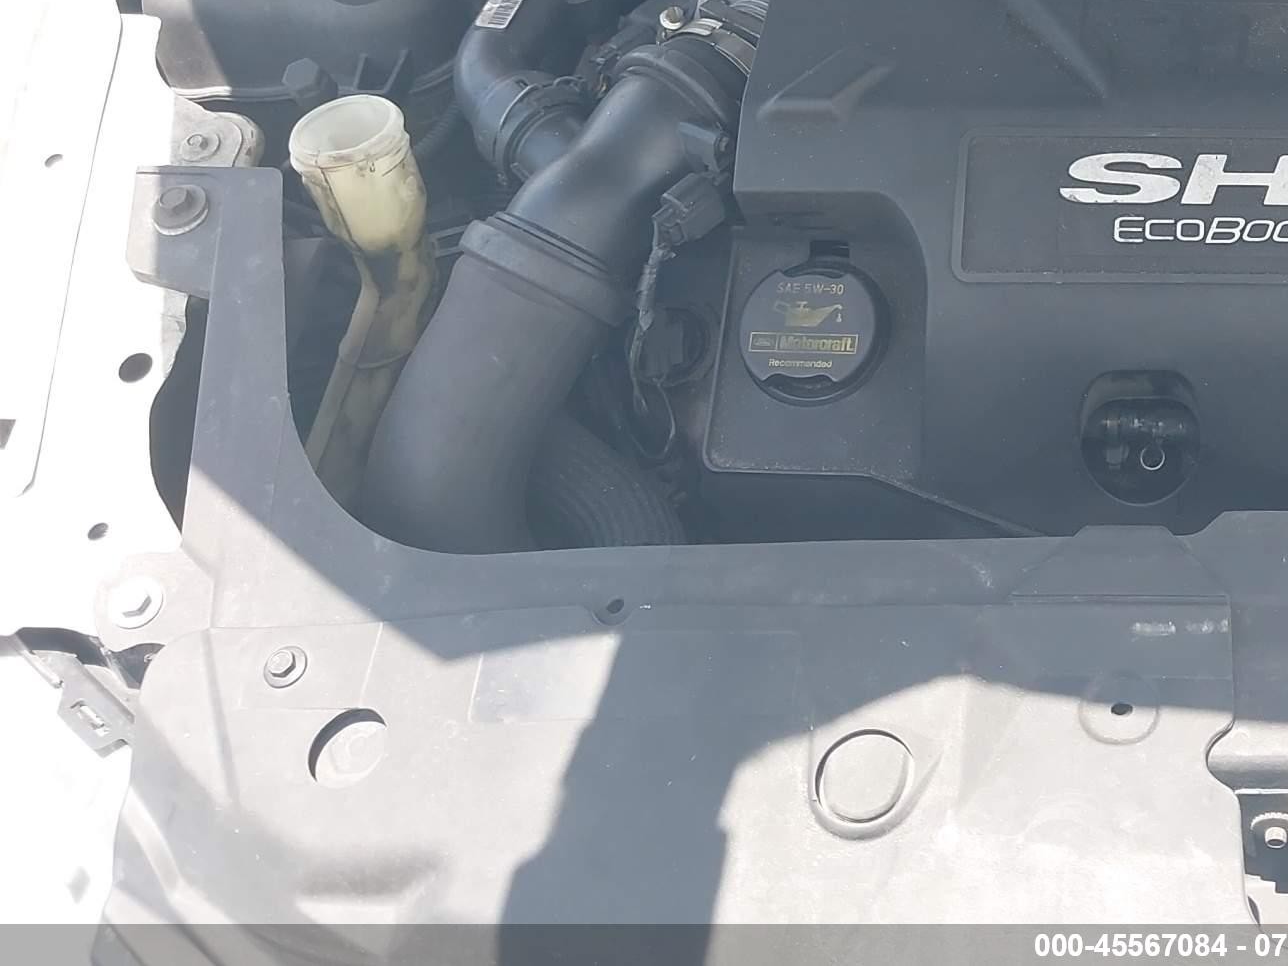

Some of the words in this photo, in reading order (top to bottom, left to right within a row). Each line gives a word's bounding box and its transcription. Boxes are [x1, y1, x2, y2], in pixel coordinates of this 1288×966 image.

[804, 283, 845, 295] 5W-30
[779, 335, 855, 352] Motorcraft
[768, 358, 833, 368] Recommended
